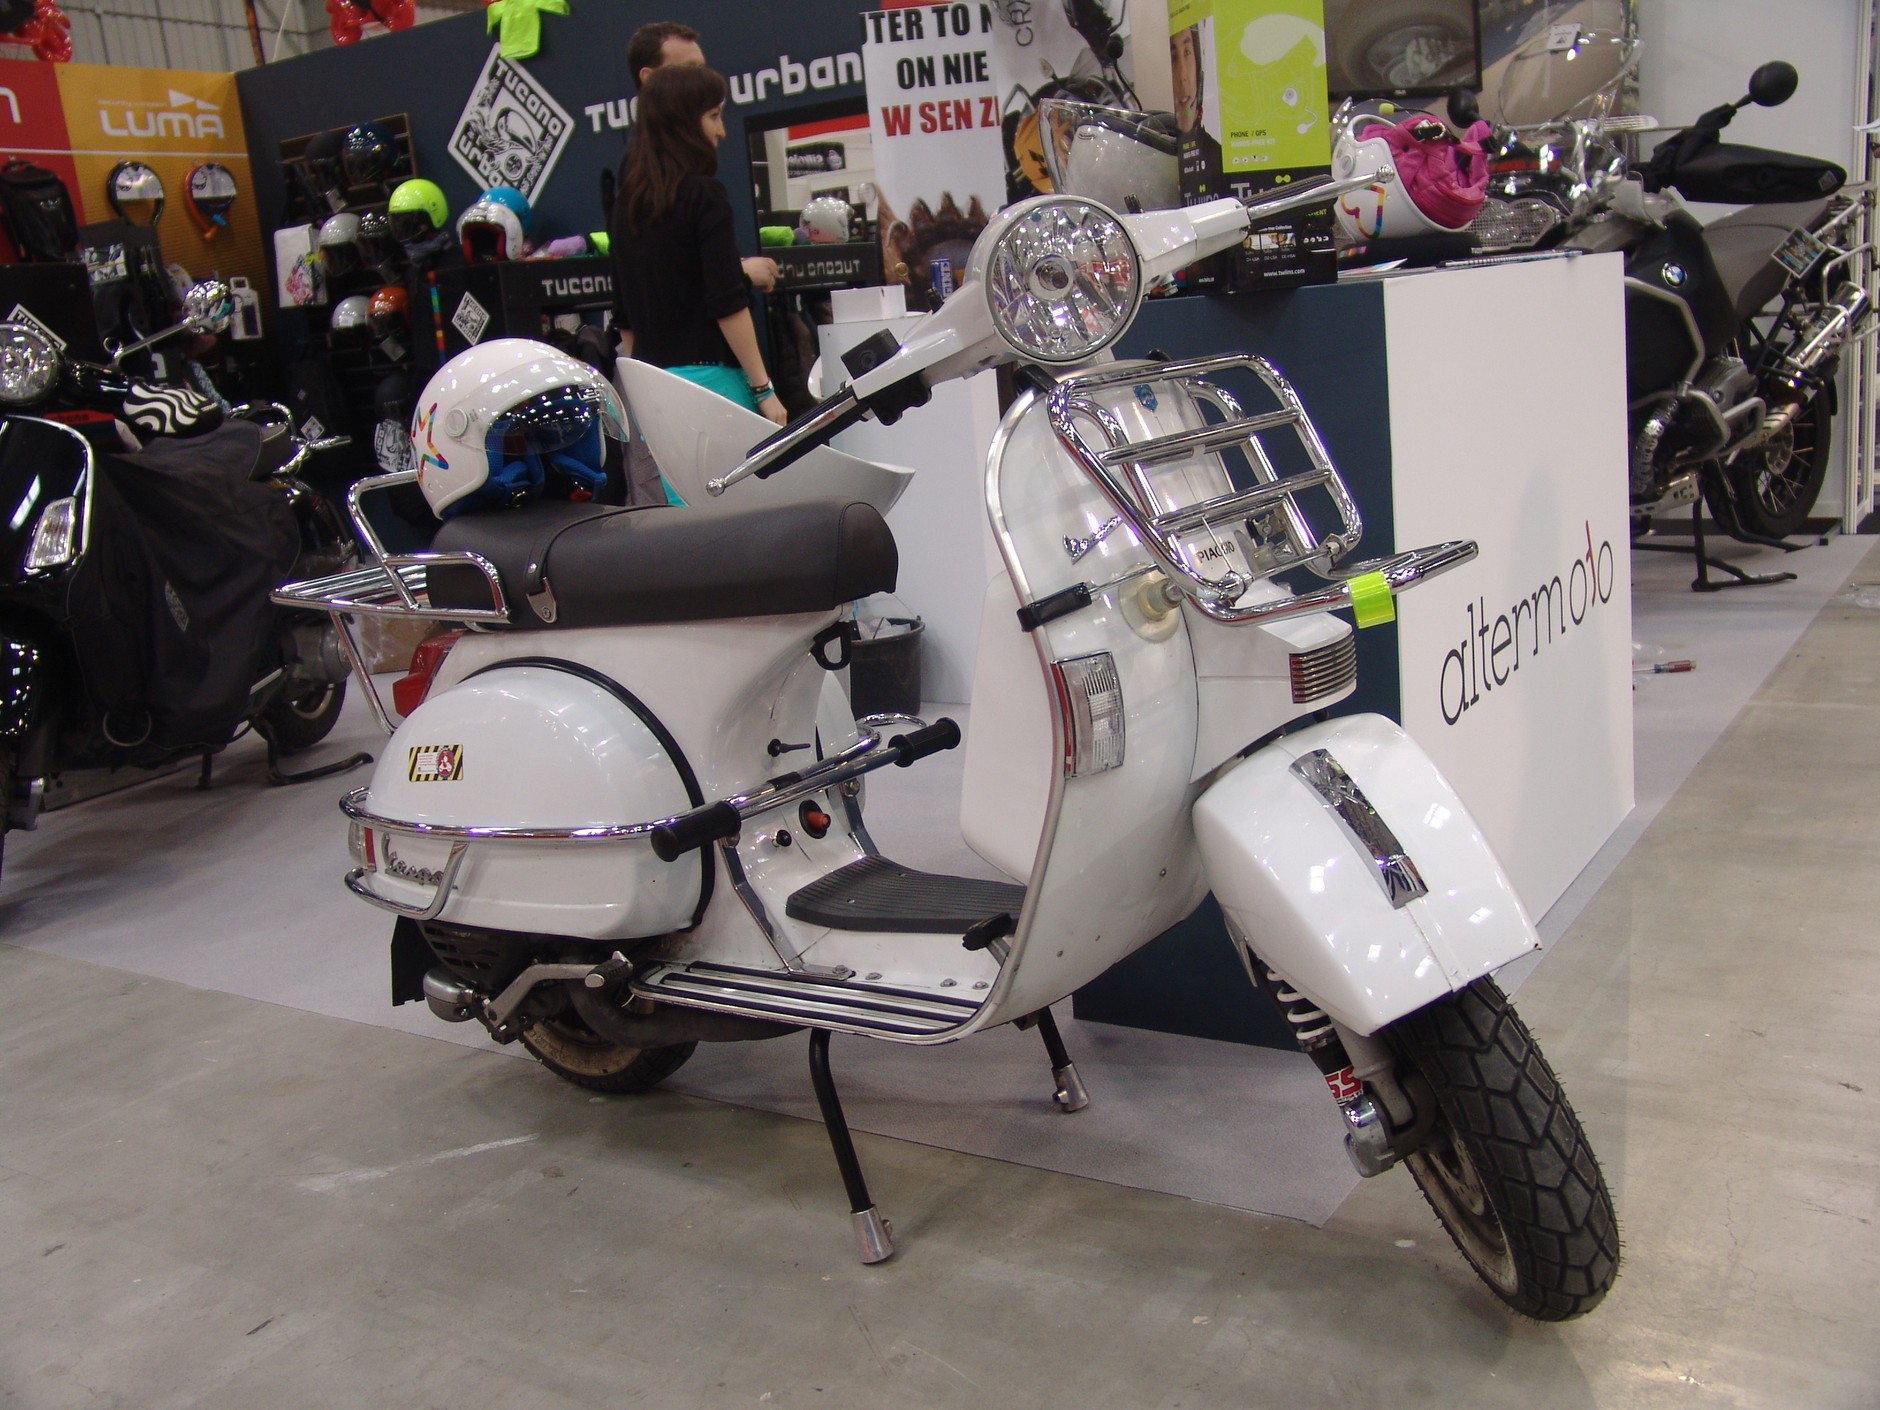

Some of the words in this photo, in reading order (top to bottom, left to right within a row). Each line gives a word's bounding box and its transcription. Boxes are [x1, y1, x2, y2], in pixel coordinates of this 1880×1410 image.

[931, 3, 970, 38] TO
[897, 55, 936, 90] ON
[943, 50, 989, 86] NIE
[99, 109, 225, 139] LUMA
[881, 104, 911, 137] W
[918, 98, 973, 134] SEN
[979, 95, 1000, 128] Z
[1230, 130, 1249, 138] PHONE
[1255, 129, 1267, 137] GPS
[1440, 520, 1614, 726] altermoto
